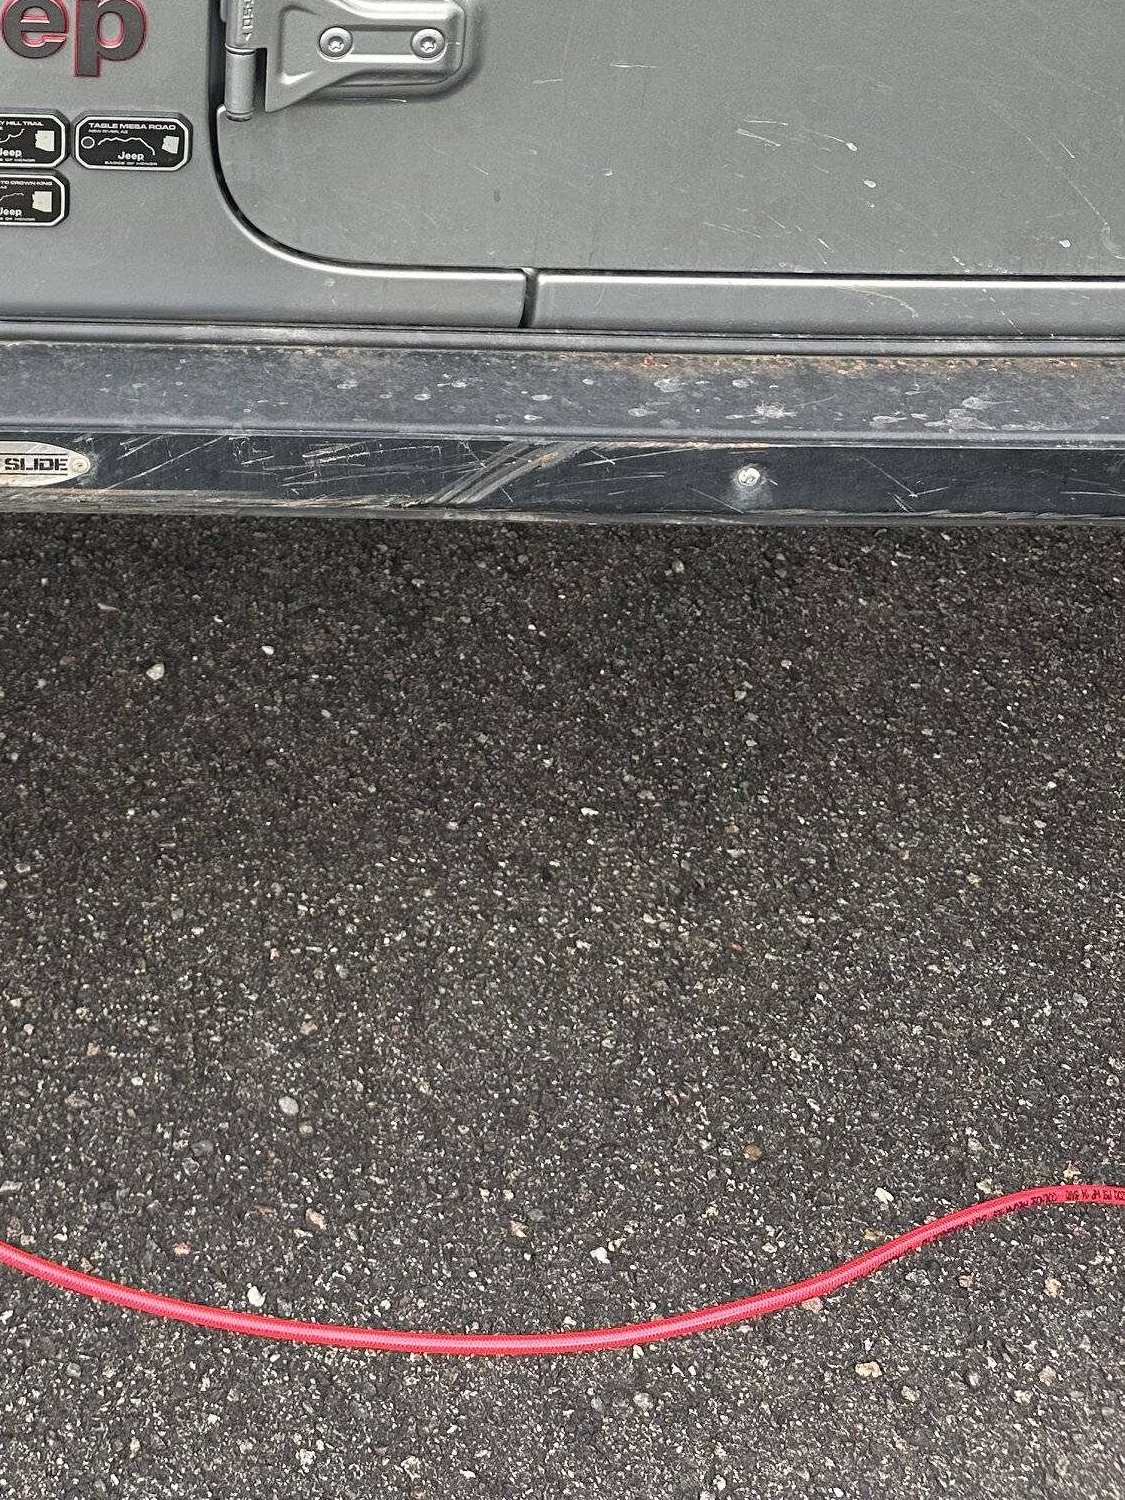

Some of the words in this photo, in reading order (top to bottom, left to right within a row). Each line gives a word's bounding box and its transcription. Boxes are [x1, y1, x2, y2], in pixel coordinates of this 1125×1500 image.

[148, 123, 176, 131] ROAD
[117, 151, 144, 161] Jeep
[4, 457, 69, 471] SLIDE
